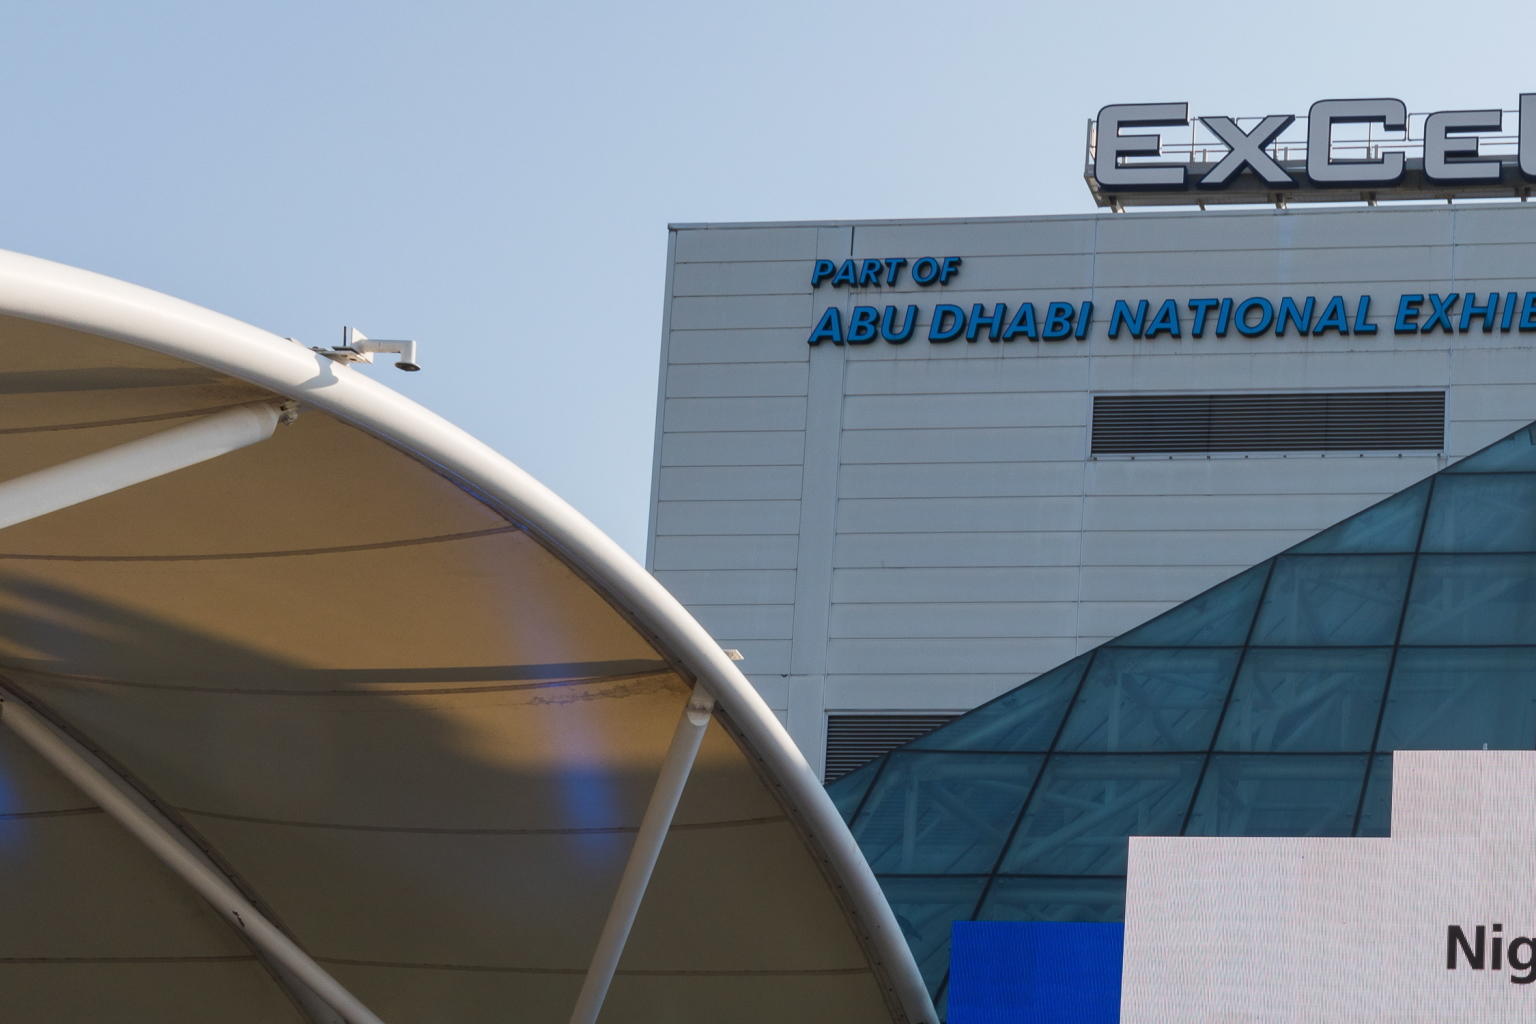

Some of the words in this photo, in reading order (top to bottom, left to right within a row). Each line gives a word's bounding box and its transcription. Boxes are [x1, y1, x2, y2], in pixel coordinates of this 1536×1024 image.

[811, 257, 907, 289] PART
[910, 255, 962, 286] OF
[808, 303, 917, 346] ABU
[928, 300, 1093, 344] DHABI
[1108, 295, 1379, 341] NATIONAL
